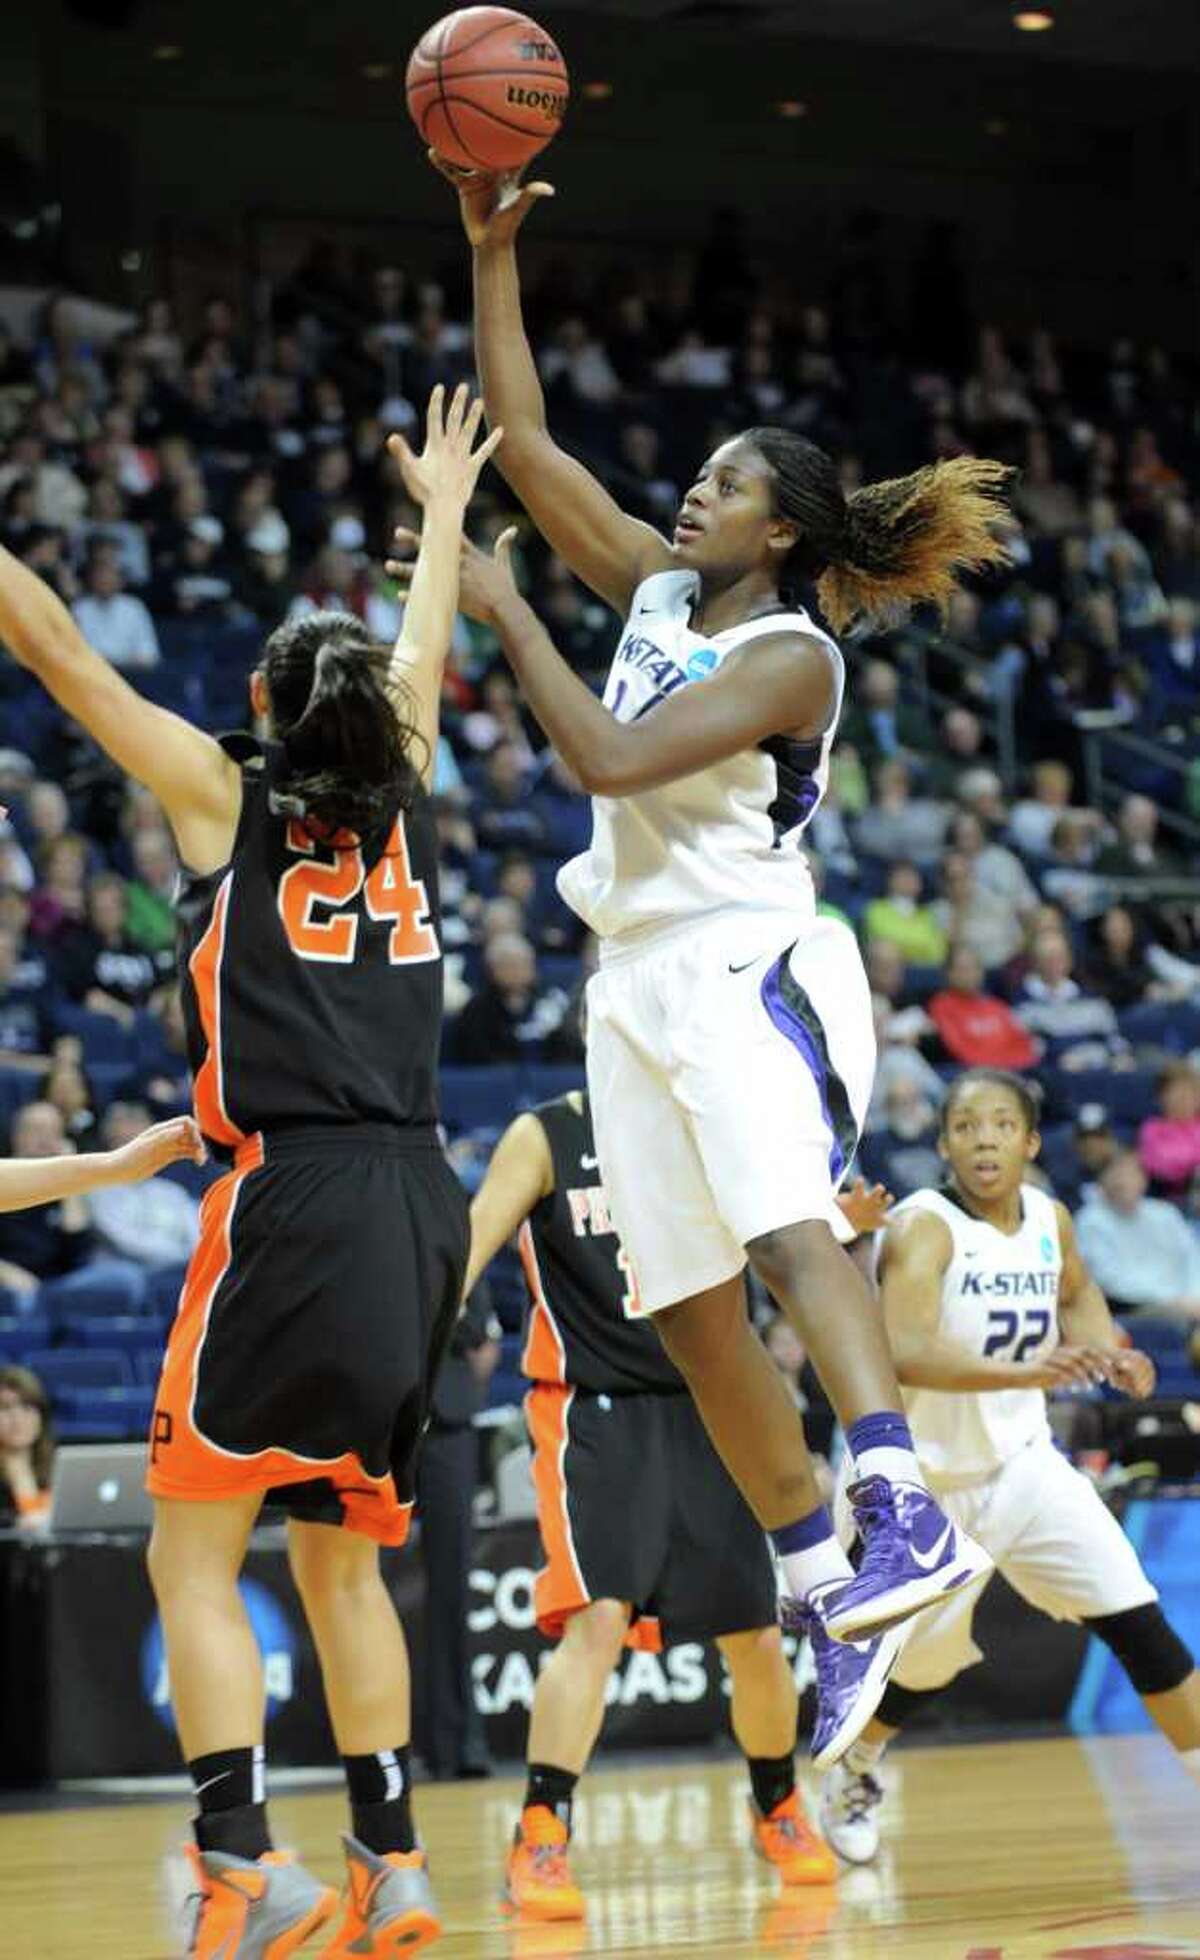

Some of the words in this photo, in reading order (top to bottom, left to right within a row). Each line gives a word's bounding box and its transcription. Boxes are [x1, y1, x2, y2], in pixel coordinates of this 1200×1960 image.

[278, 809, 441, 966] 24
[960, 1271, 1057, 1296] K-STATE
[982, 1310, 1051, 1363] 22
[151, 1409, 173, 1464] P
